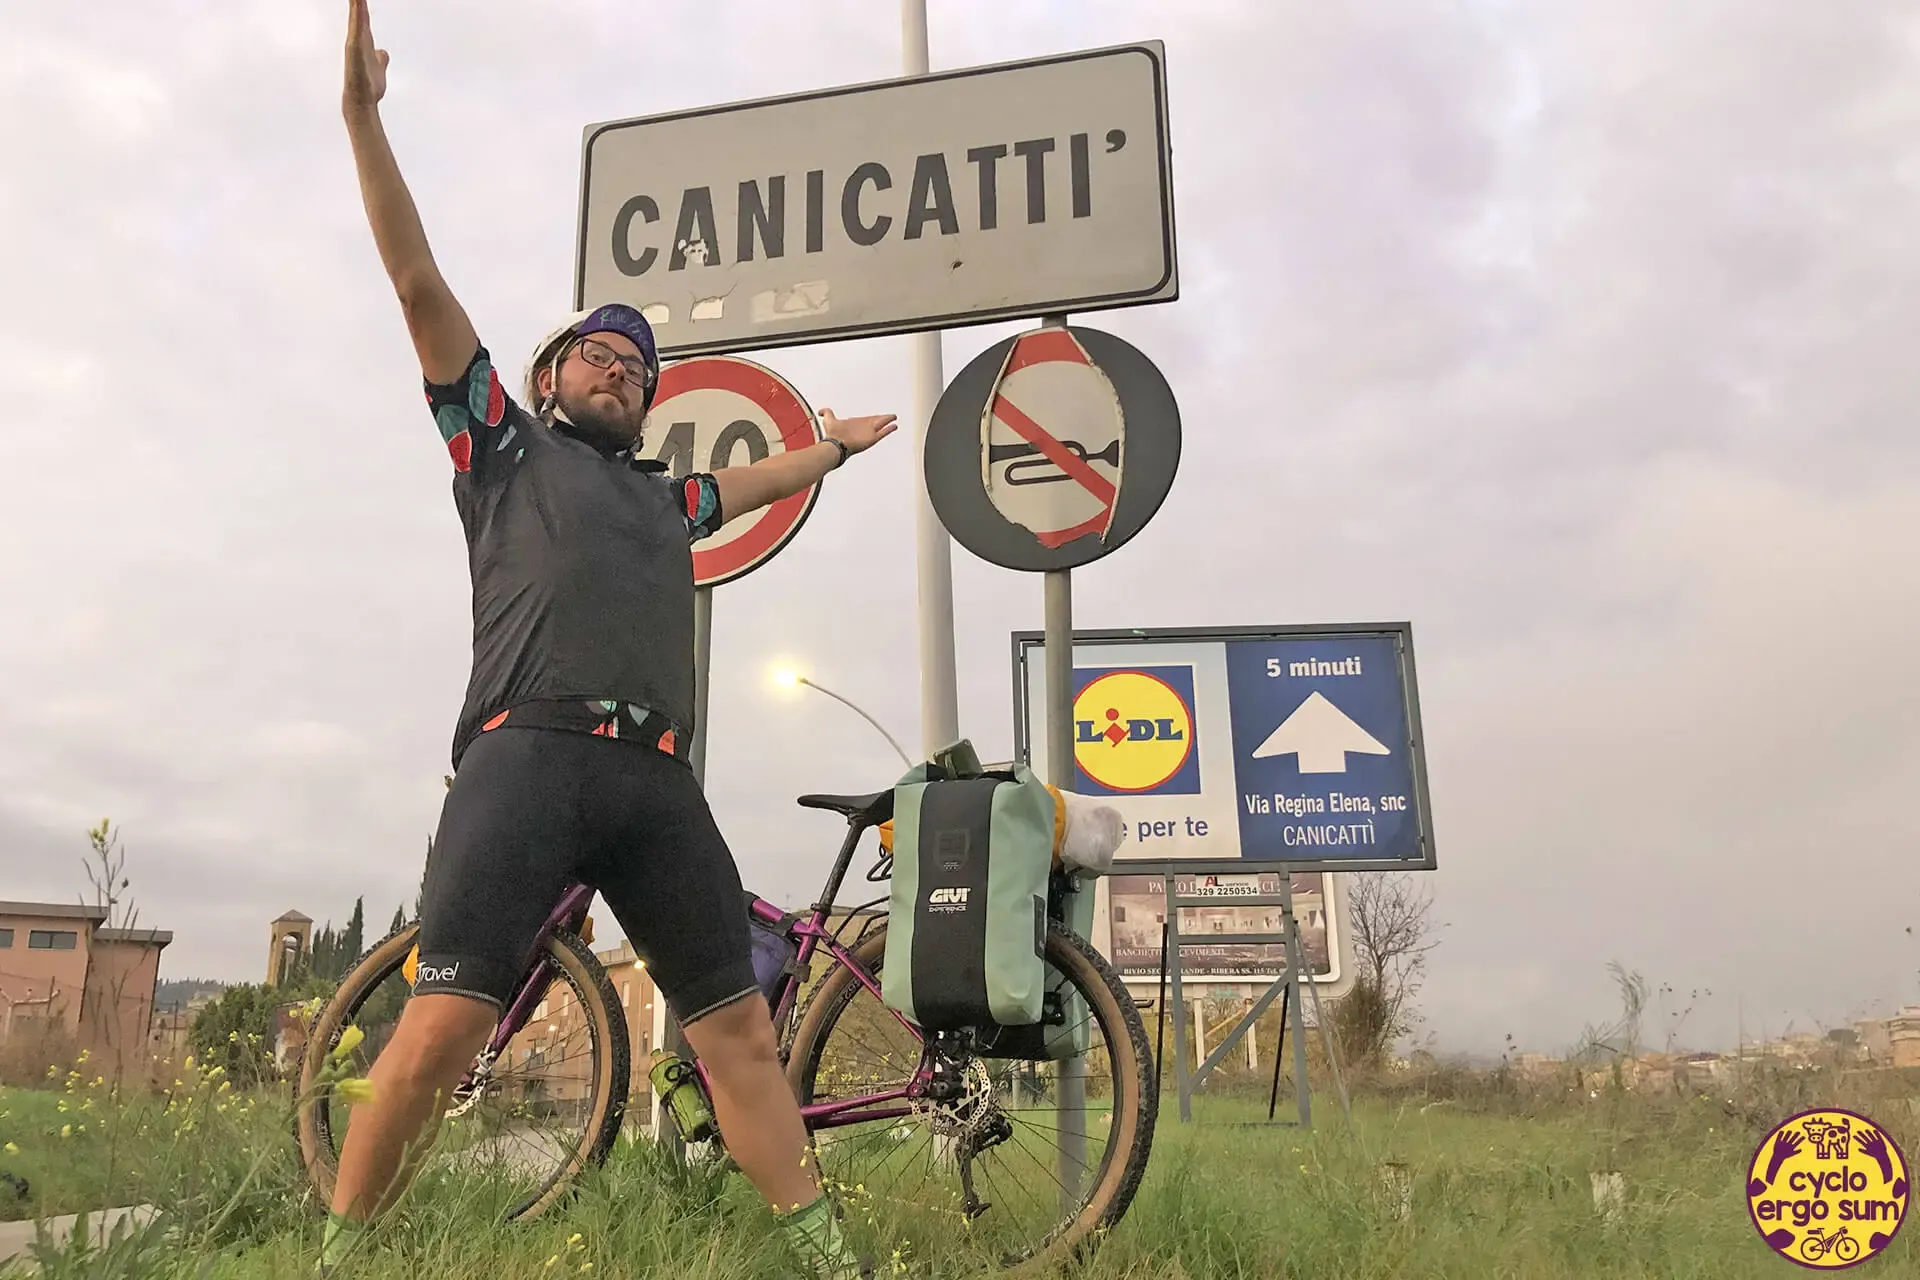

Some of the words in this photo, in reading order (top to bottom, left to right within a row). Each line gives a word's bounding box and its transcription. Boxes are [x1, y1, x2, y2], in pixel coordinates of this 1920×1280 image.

[611, 128, 1127, 277] CANICATTI'
[1266, 658, 1281, 678] 5
[1290, 656, 1362, 677] minuti
[1245, 795, 1270, 815] Via
[1275, 795, 1324, 817] Regina
[1330, 793, 1376, 815] Elena,
[1381, 796, 1406, 812] snc
[1138, 818, 1176, 842] per
[1185, 816, 1209, 836] te
[1283, 818, 1375, 846] CANICATTÌ
[1205, 875, 1224, 887] AL
[1217, 886, 1257, 896] 2250534
[929, 887, 969, 904] GIVI
[416, 961, 460, 982] Travel
